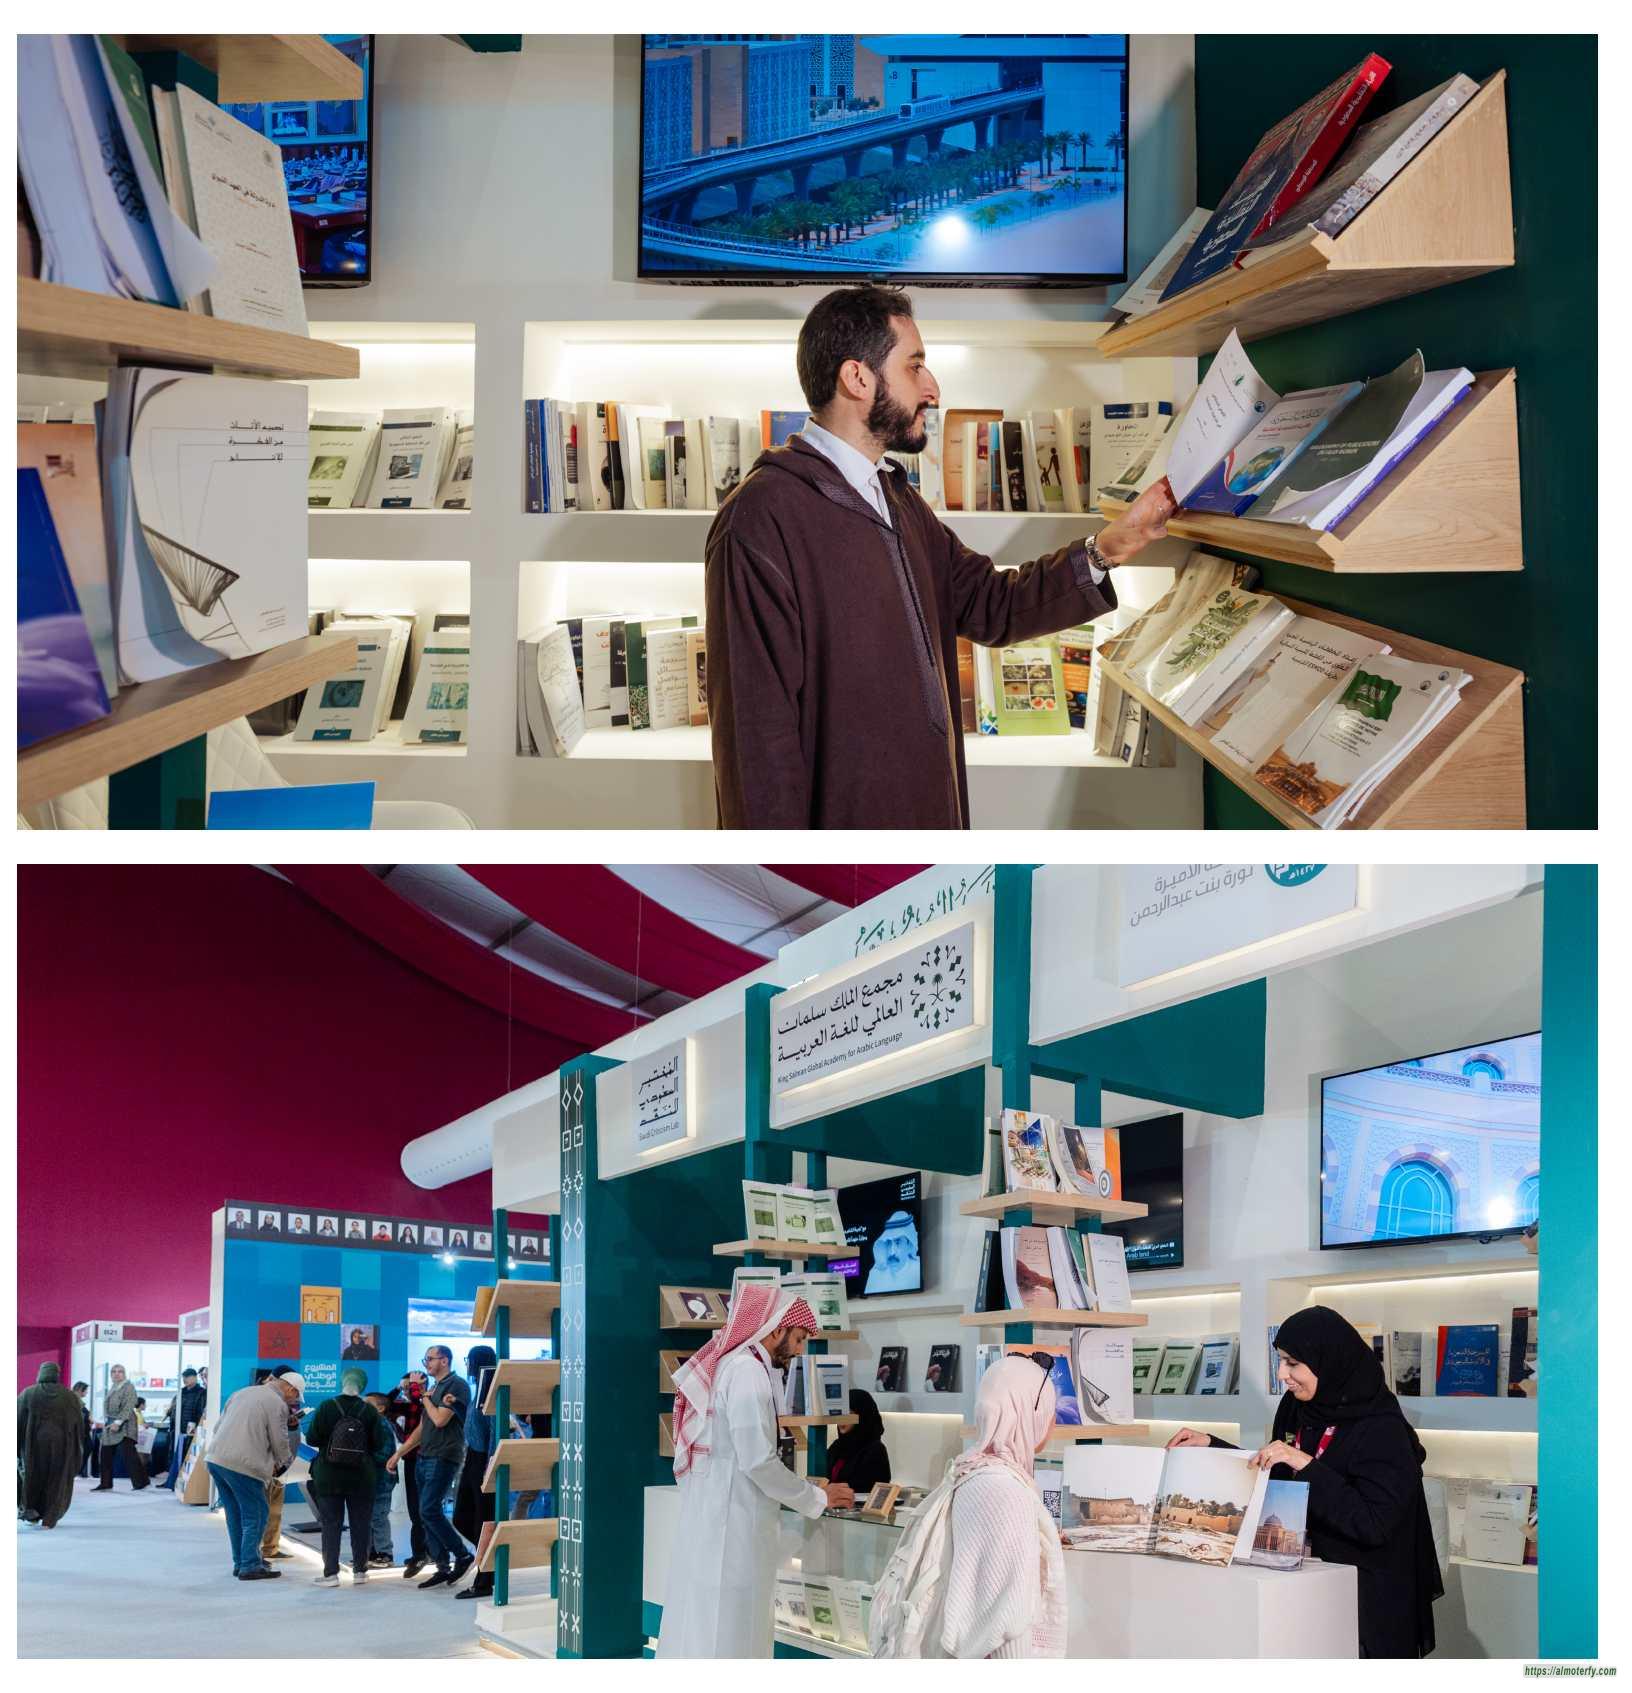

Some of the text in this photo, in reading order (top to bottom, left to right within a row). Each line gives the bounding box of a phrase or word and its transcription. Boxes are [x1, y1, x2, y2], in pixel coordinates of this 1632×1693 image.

[1195, 878, 1221, 897] بنت
[777, 972, 903, 1036] مجمع الملك سلمان
[777, 996, 903, 1063] العالمي للغة العربية
[856, 1042, 874, 1055] Arabic
[874, 1032, 903, 1047] Language
